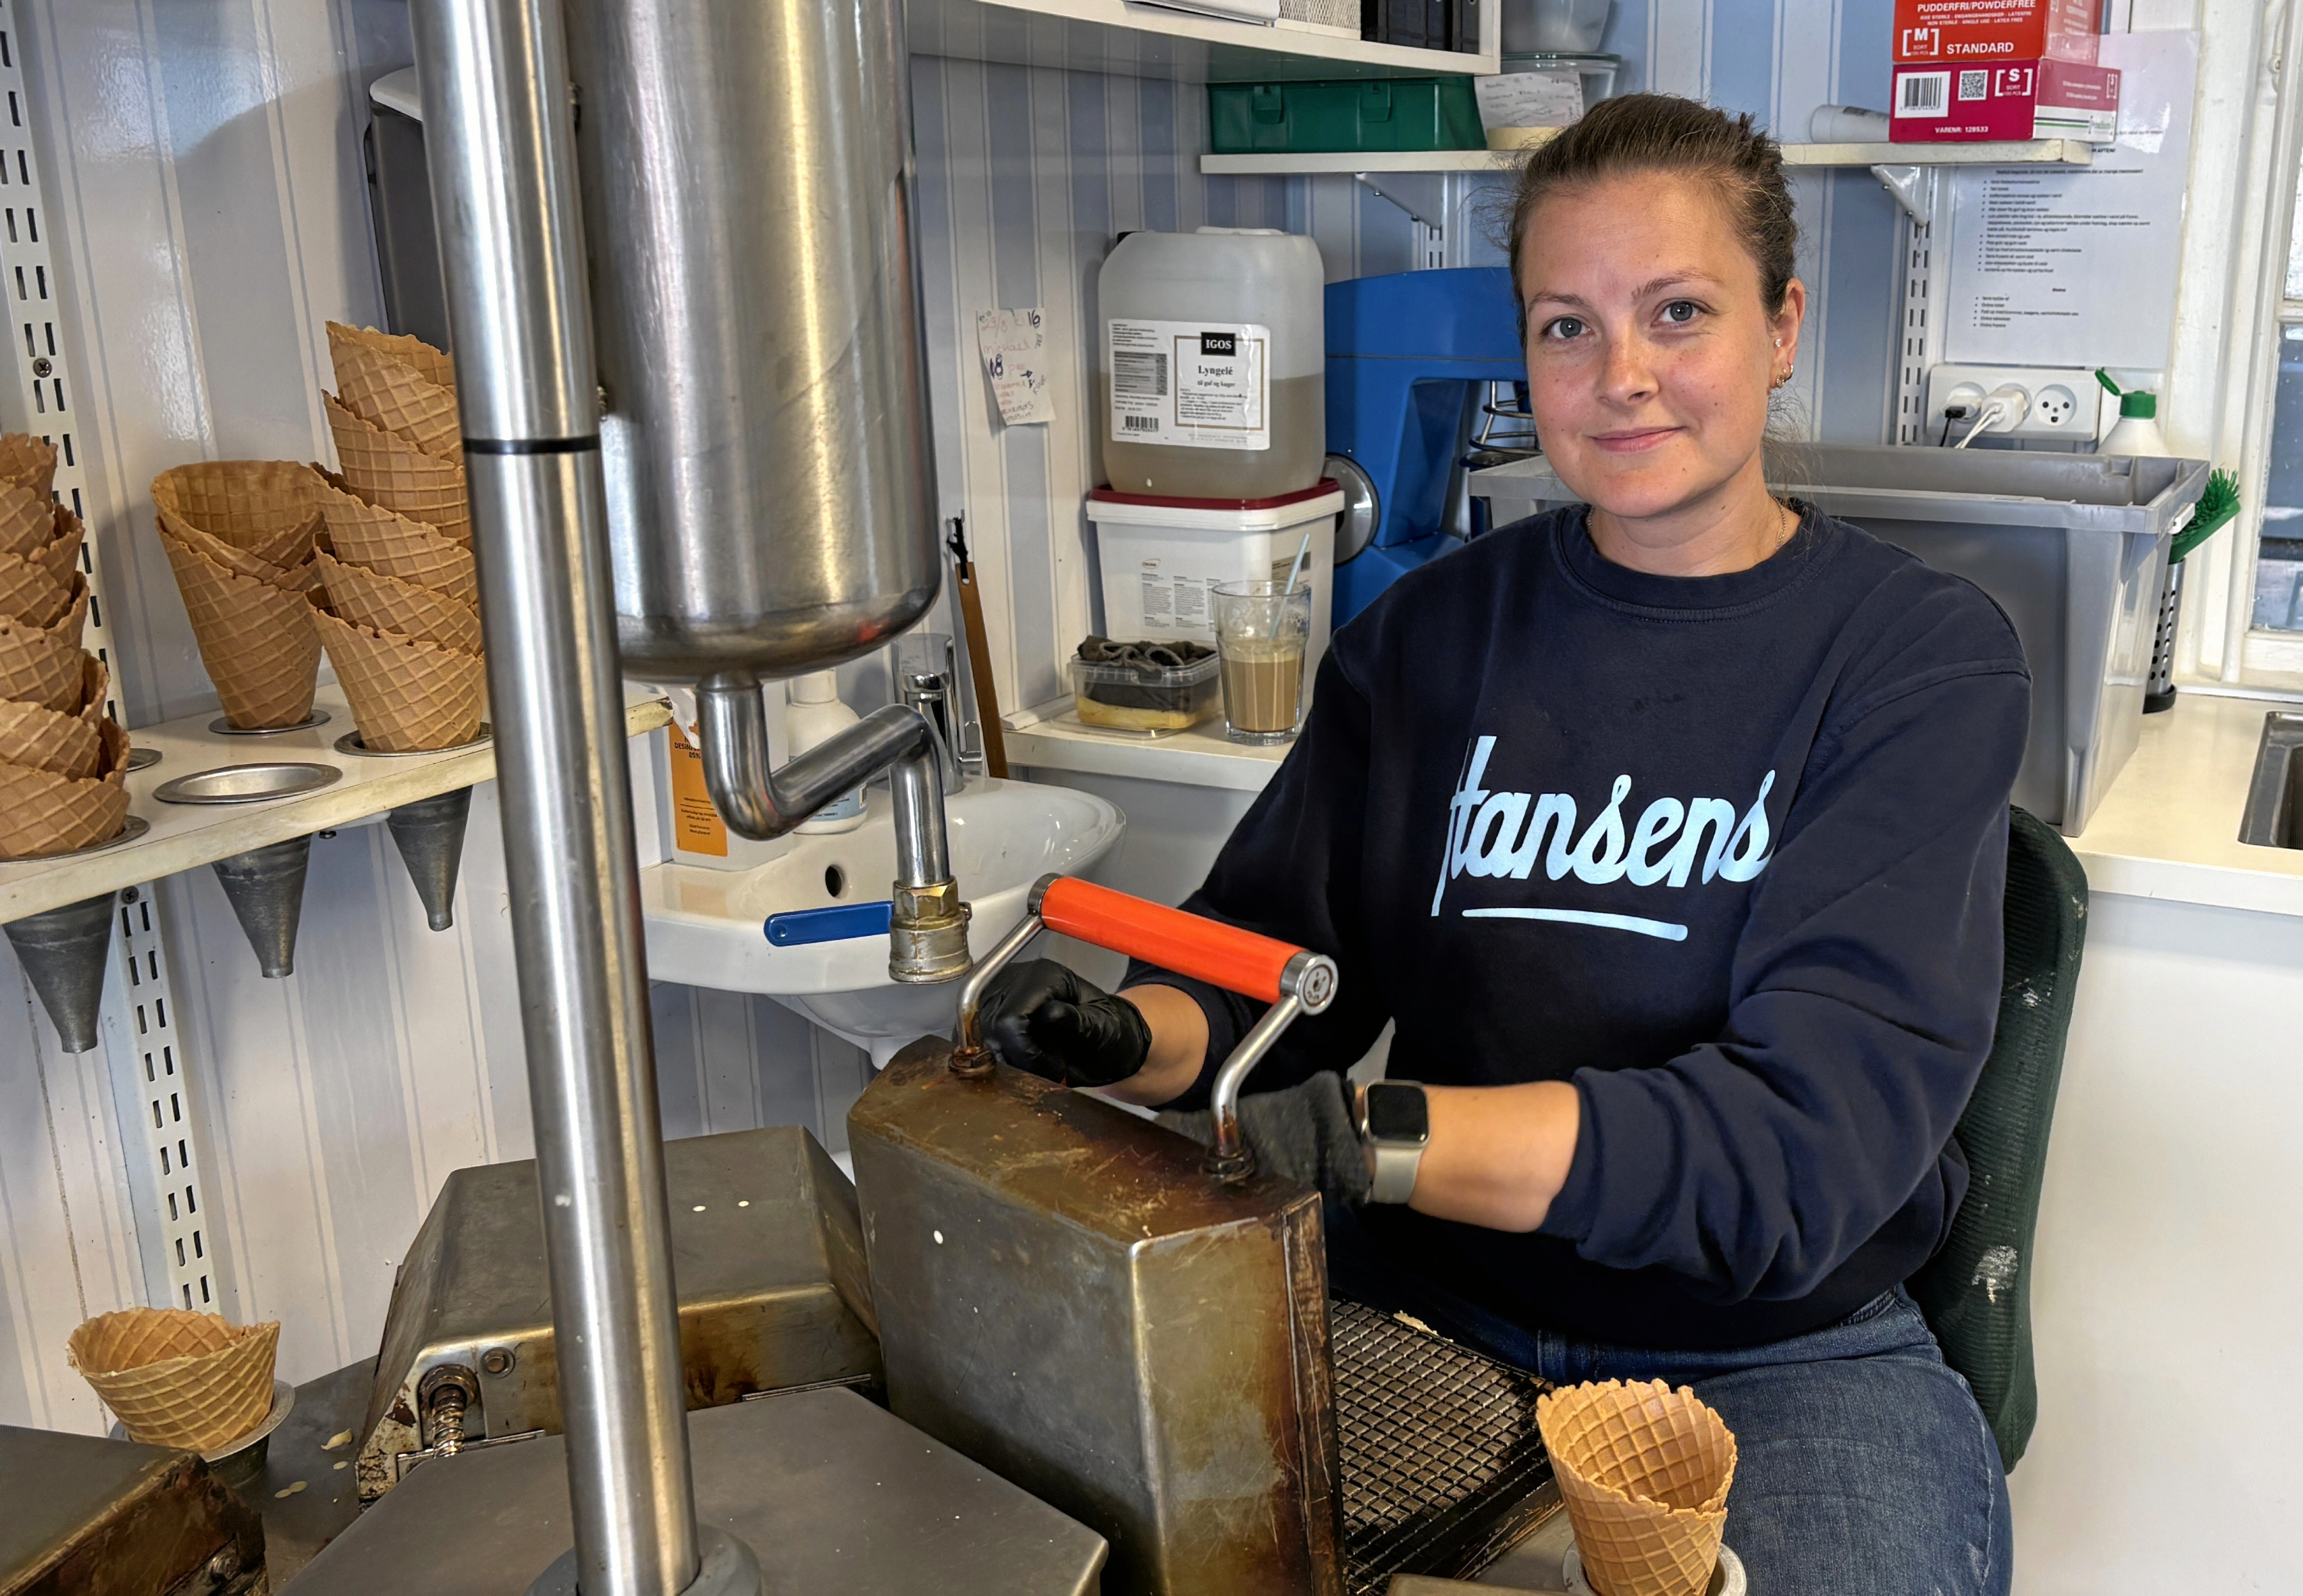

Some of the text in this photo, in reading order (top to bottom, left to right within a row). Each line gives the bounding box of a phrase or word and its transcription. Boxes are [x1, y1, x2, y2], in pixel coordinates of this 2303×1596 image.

[1918, 0, 2036, 12] PUDDERFRI/POWDERFREE
[1947, 41, 2014, 55] STANDARD
[1205, 339, 1232, 349] IGOS
[1198, 365, 1234, 377] Lyngelé
